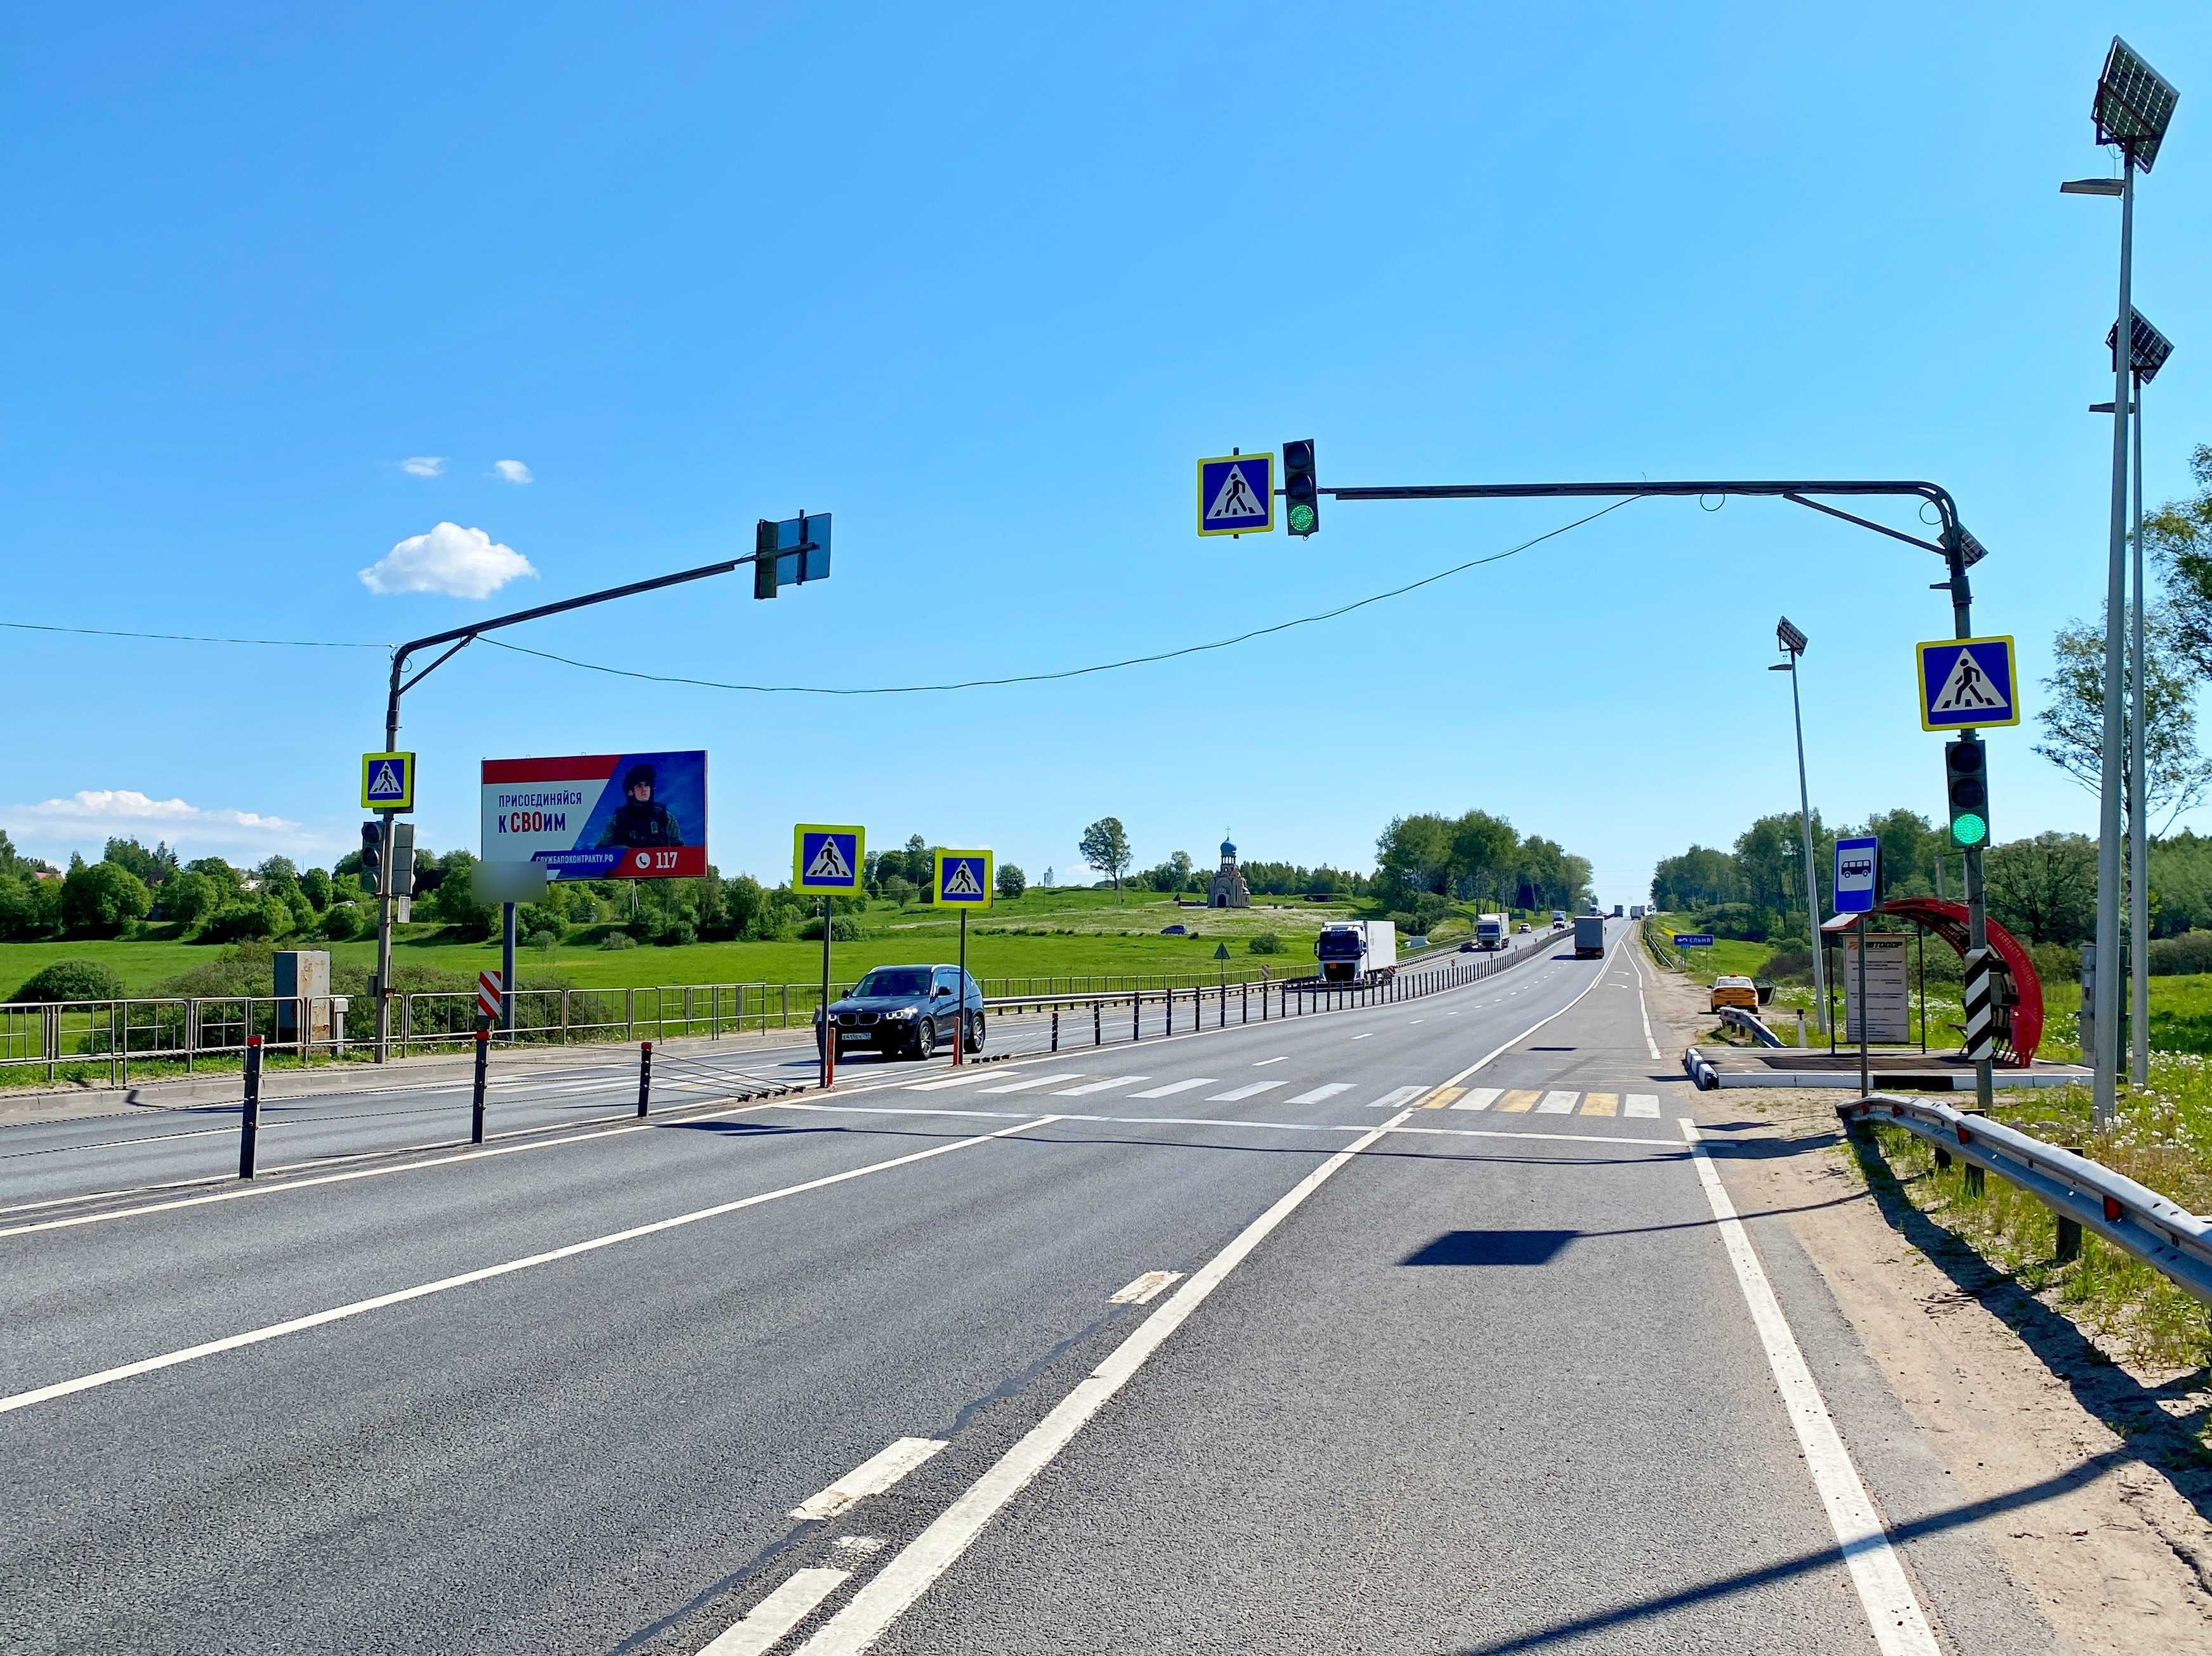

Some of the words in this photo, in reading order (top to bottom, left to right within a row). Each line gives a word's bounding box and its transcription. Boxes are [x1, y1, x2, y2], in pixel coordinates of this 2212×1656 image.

[499, 790, 582, 807] ПРИСОЕДИНЯЙСЯ
[499, 814, 507, 833] К
[511, 811, 566, 833] СВОИМ
[655, 851, 678, 869] 117
